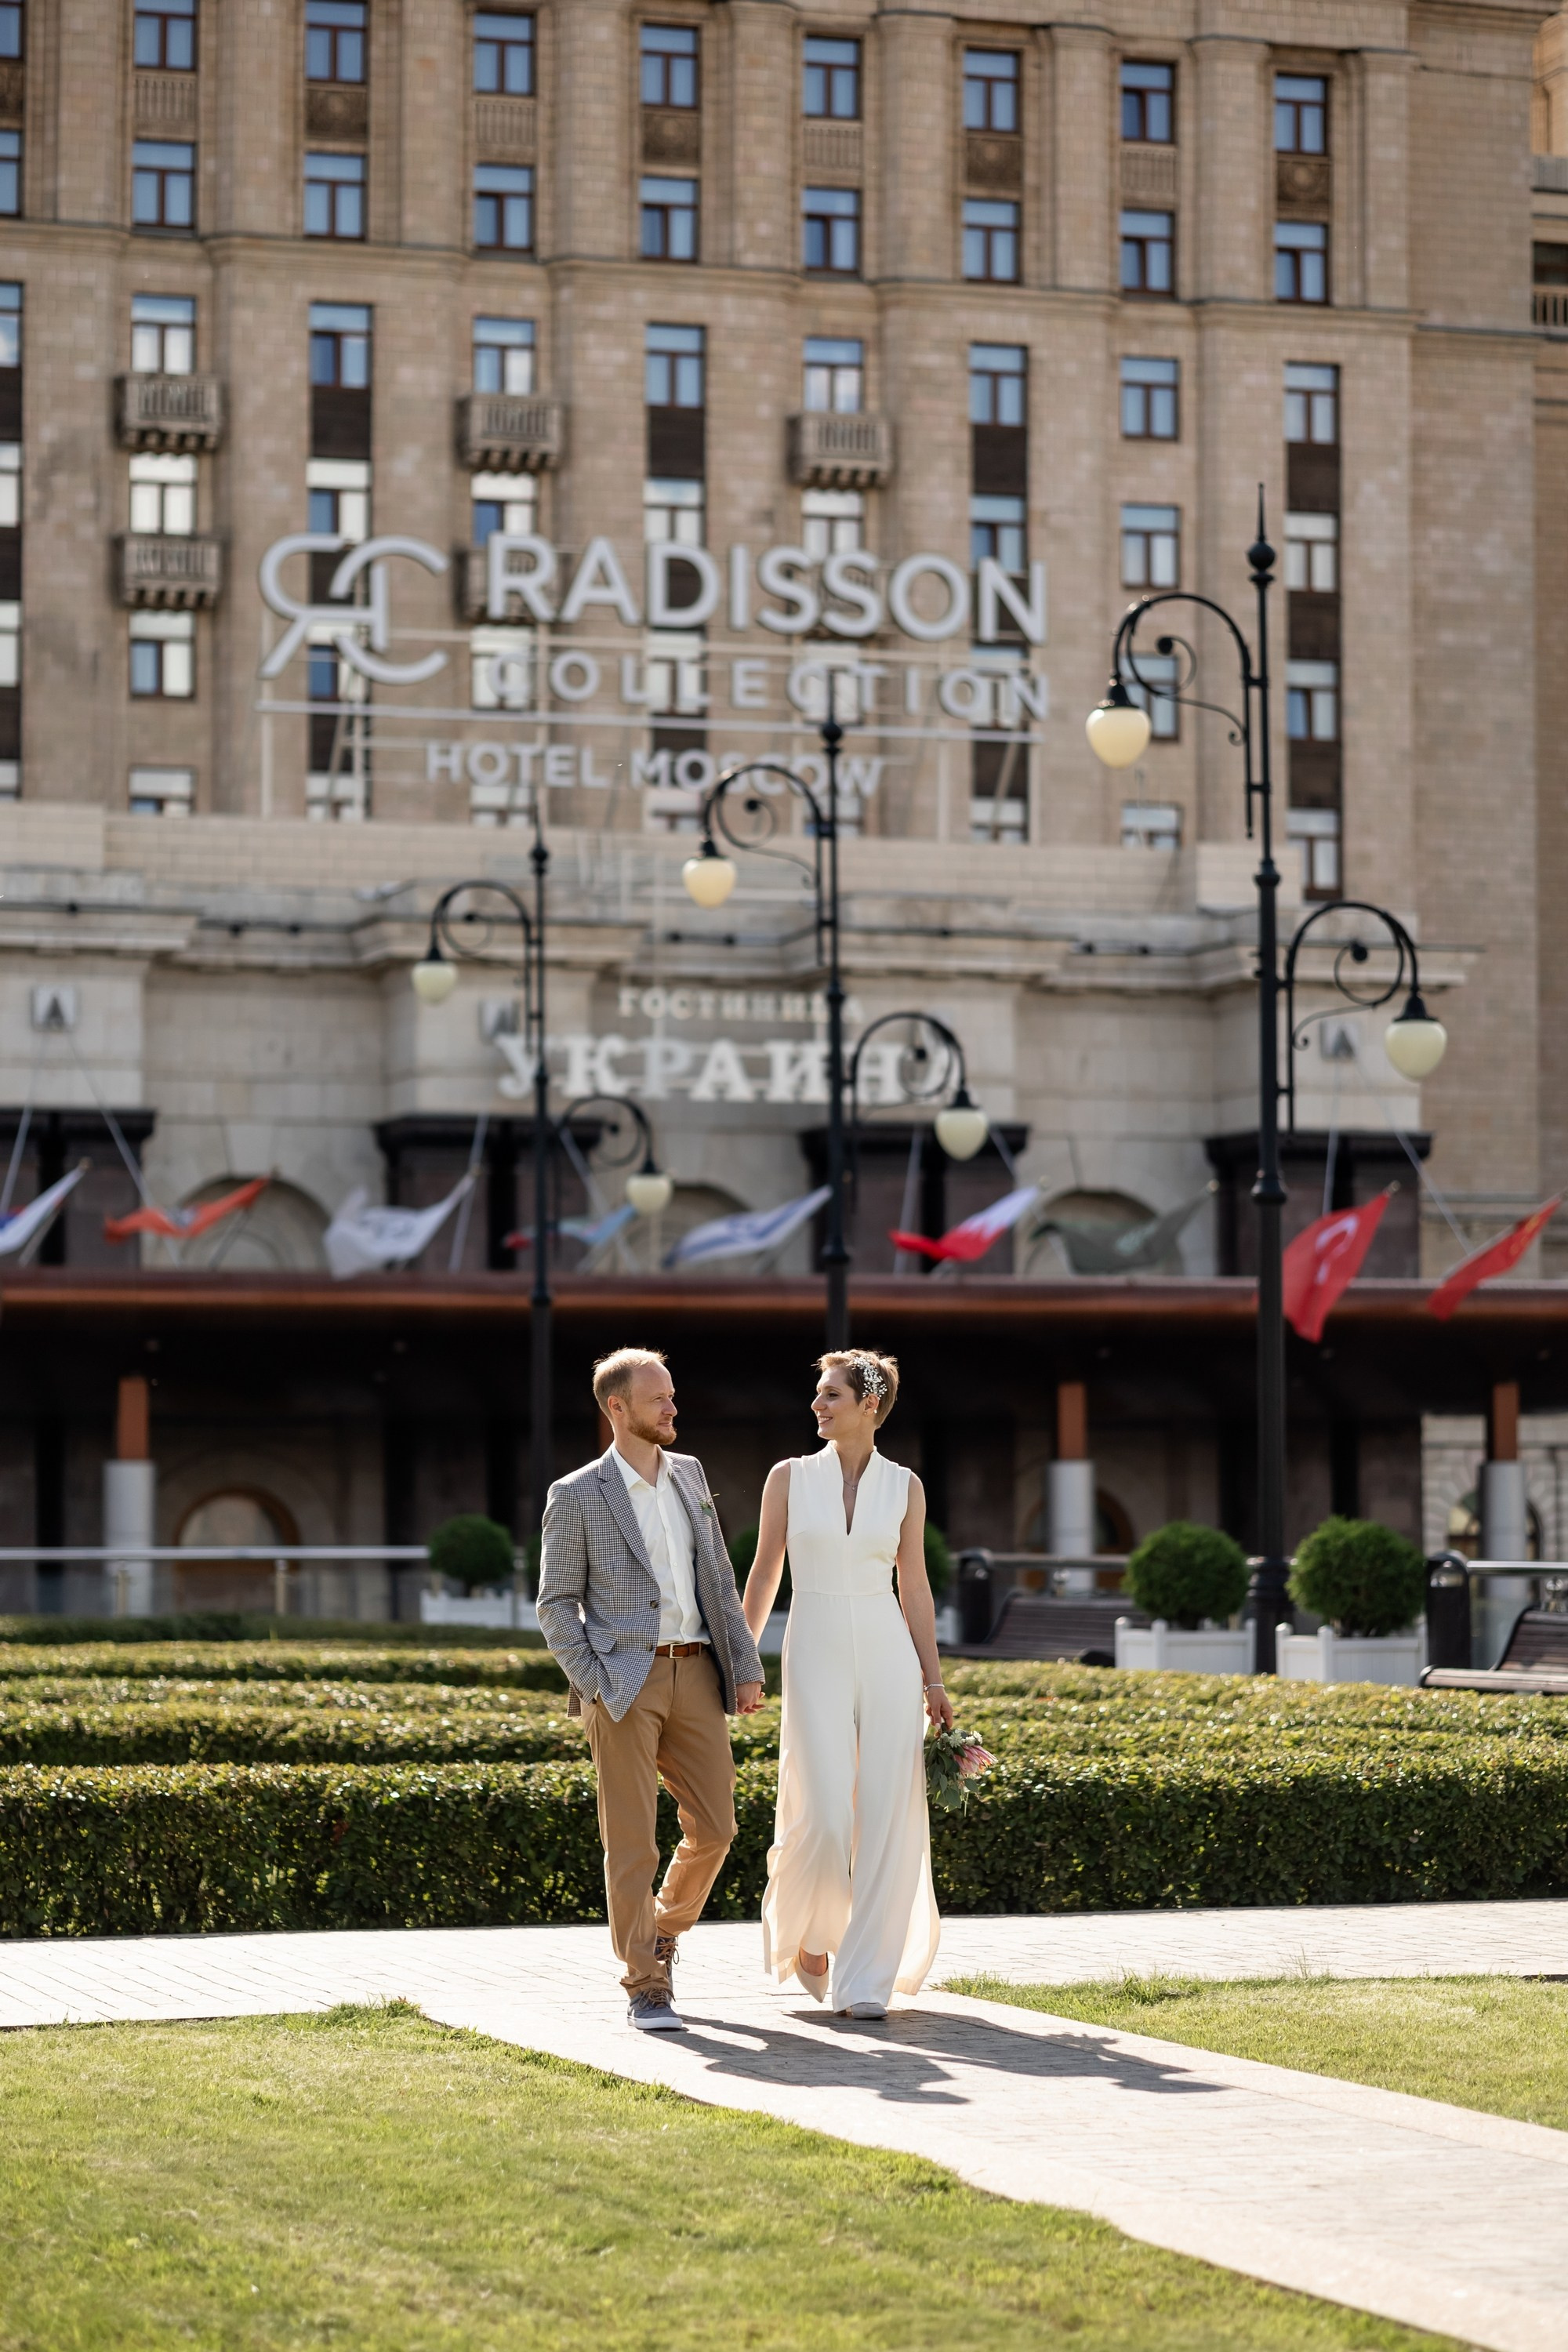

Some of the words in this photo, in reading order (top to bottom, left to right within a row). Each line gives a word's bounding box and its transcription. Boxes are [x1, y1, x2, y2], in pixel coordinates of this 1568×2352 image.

[486, 531, 1047, 645] RADISSON
[486, 652, 1049, 722] COLLECTION
[426, 742, 610, 786] HOTEL
[630, 746, 884, 799] MOSCOW
